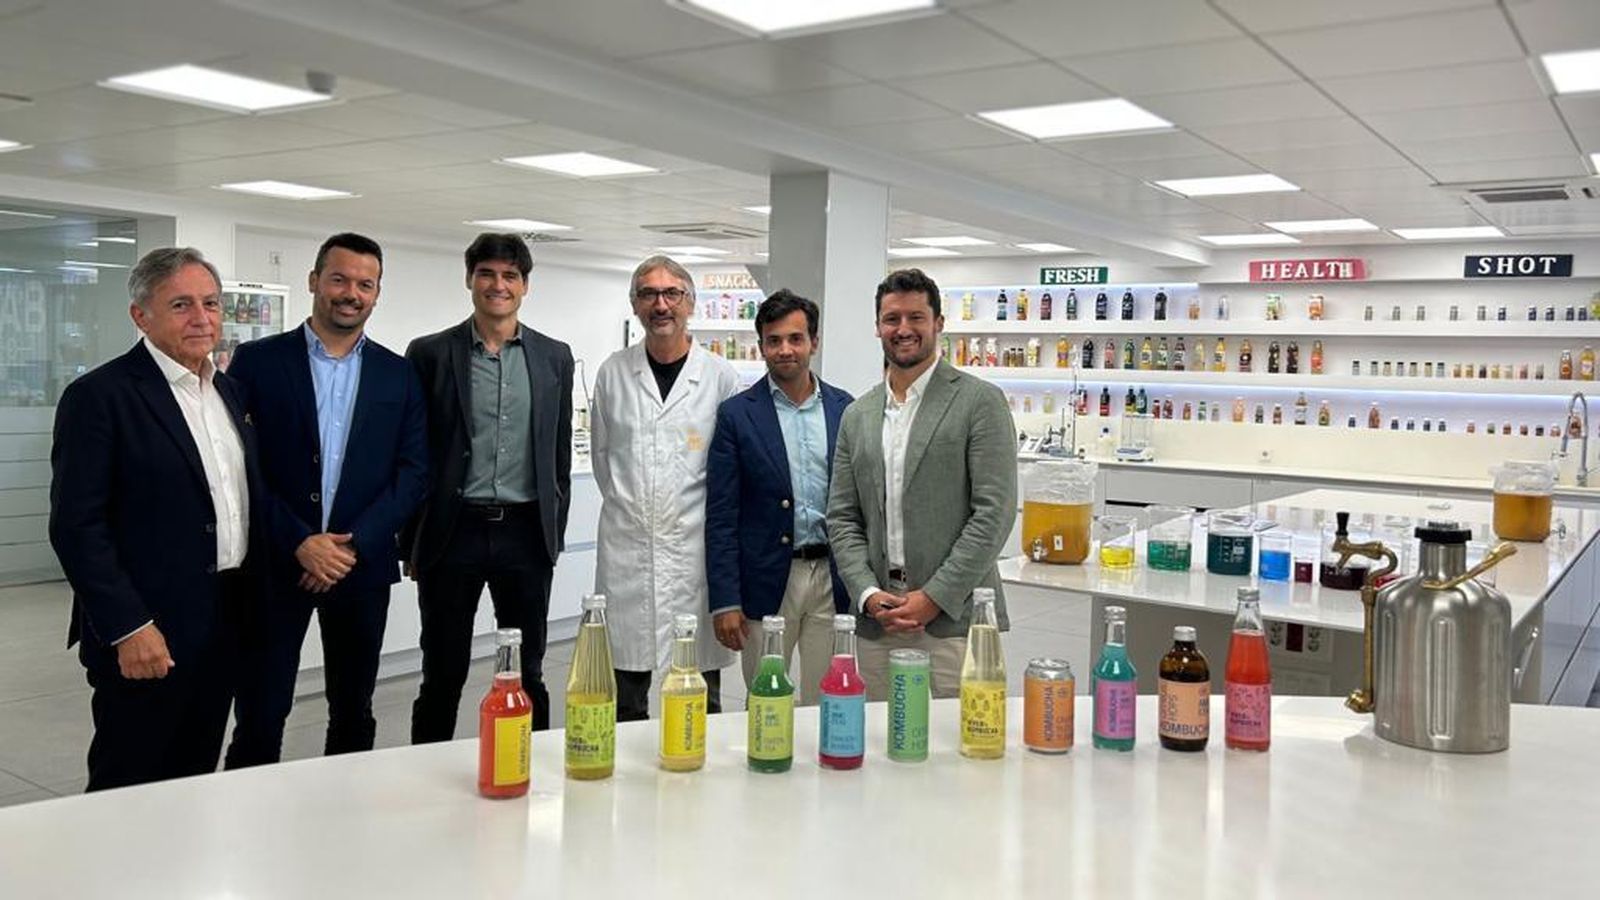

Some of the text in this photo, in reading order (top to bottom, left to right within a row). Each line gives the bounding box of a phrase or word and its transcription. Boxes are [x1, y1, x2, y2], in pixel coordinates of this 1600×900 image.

[1261, 261, 1354, 279] HEALTH
[1477, 256, 1557, 275] SHOT
[1044, 267, 1100, 284] FRESH
[893, 673, 906, 751] KOMBUCHA
